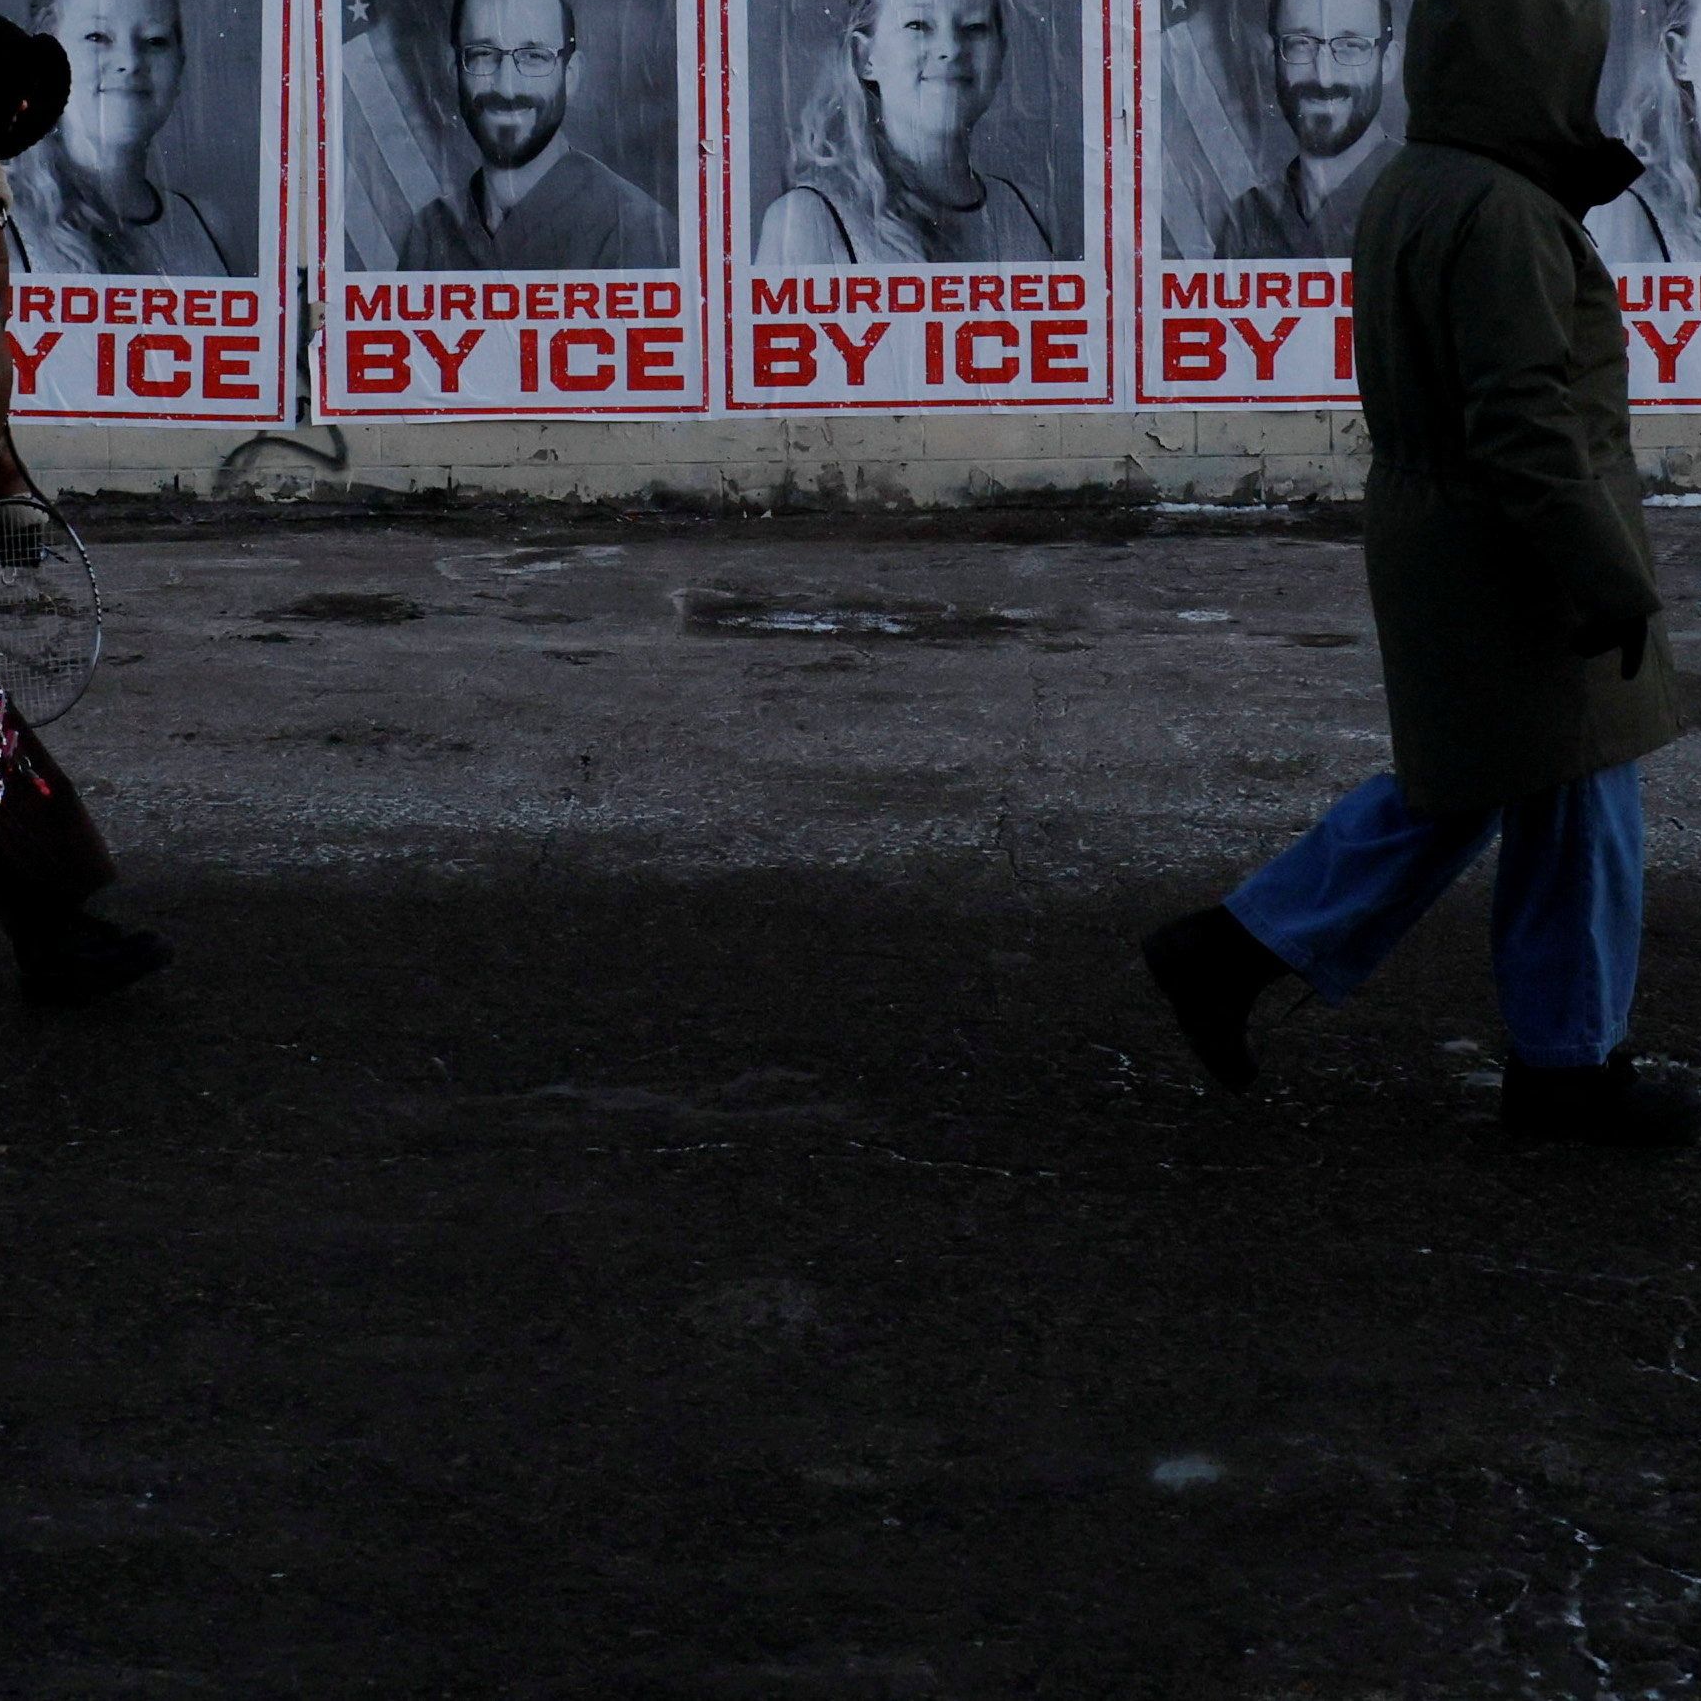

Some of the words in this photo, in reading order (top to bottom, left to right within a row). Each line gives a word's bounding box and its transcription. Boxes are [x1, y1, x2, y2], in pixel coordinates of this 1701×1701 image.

[8, 287, 258, 326] RDERED
[346, 283, 680, 320] MURDERED
[753, 275, 1085, 314] MURDERED
[1163, 272, 1353, 308] MURD
[4, 333, 61, 394] Y
[98, 334, 259, 398] ICE
[347, 330, 483, 393] BY
[521, 328, 683, 391] ICE
[754, 323, 889, 386] BY
[927, 321, 1088, 384] ICE
[1164, 318, 1298, 380] BY
[1636, 321, 1701, 382] Y
